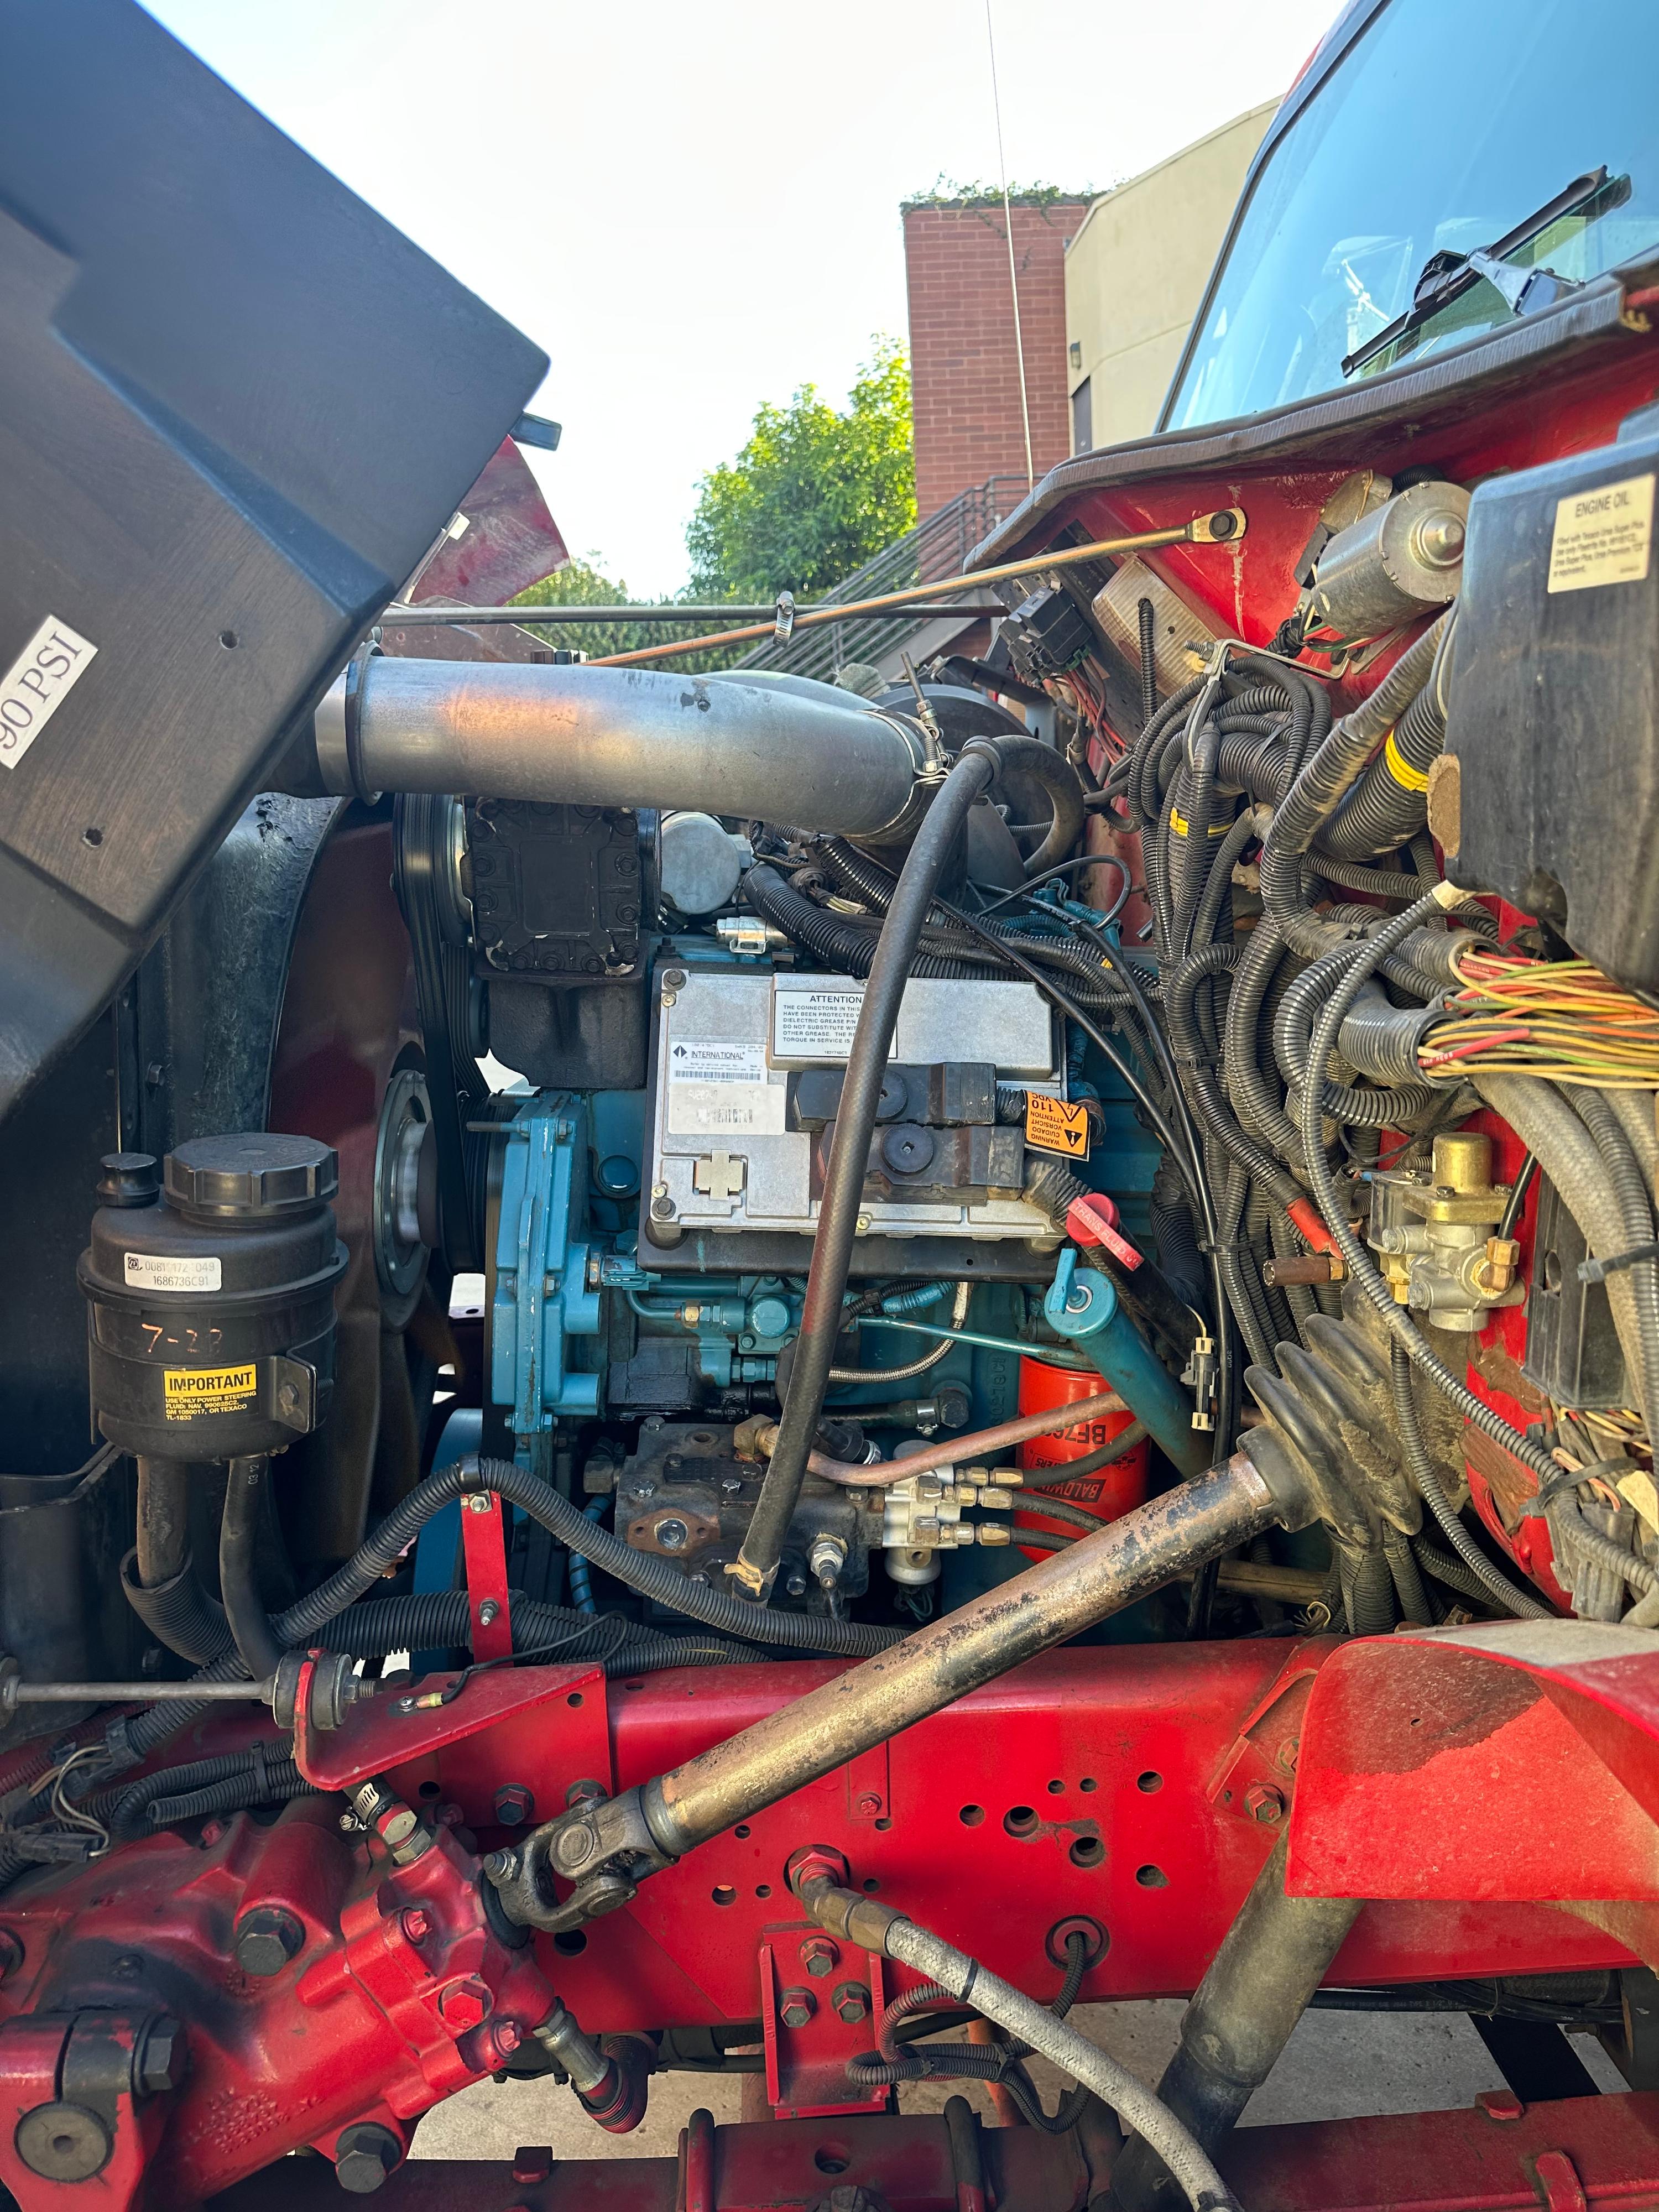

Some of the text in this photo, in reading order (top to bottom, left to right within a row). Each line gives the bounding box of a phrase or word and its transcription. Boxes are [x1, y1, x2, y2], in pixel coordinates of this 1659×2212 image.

[1575, 491, 1630, 518] ENGINE OIL
[18, 631, 82, 703] PSI
[810, 995, 862, 1004] ATTENTION
[691, 1050, 744, 1060] INTERNATIONAL
[1031, 1100, 1054, 1113] 110
[1030, 1111, 1065, 1124] ATTENTION
[1031, 1119, 1062, 1131] VORSICHT
[1032, 1126, 1060, 1138] CUIDADO
[1031, 1133, 1060, 1146] WARNING
[1075, 1202, 1103, 1232] TRANS
[195, 1262, 215, 1272] 049
[153, 1275, 208, 1286] 1686736C91
[169, 1371, 253, 1391] IMPORTANT
[224, 1390, 257, 1401] STEERING
[221, 1404, 248, 1412] TEXACO
[1044, 1423, 1106, 1445] BF7
[248, 1474, 258, 1484] 03
[1041, 1482, 1100, 1499] BALDW
